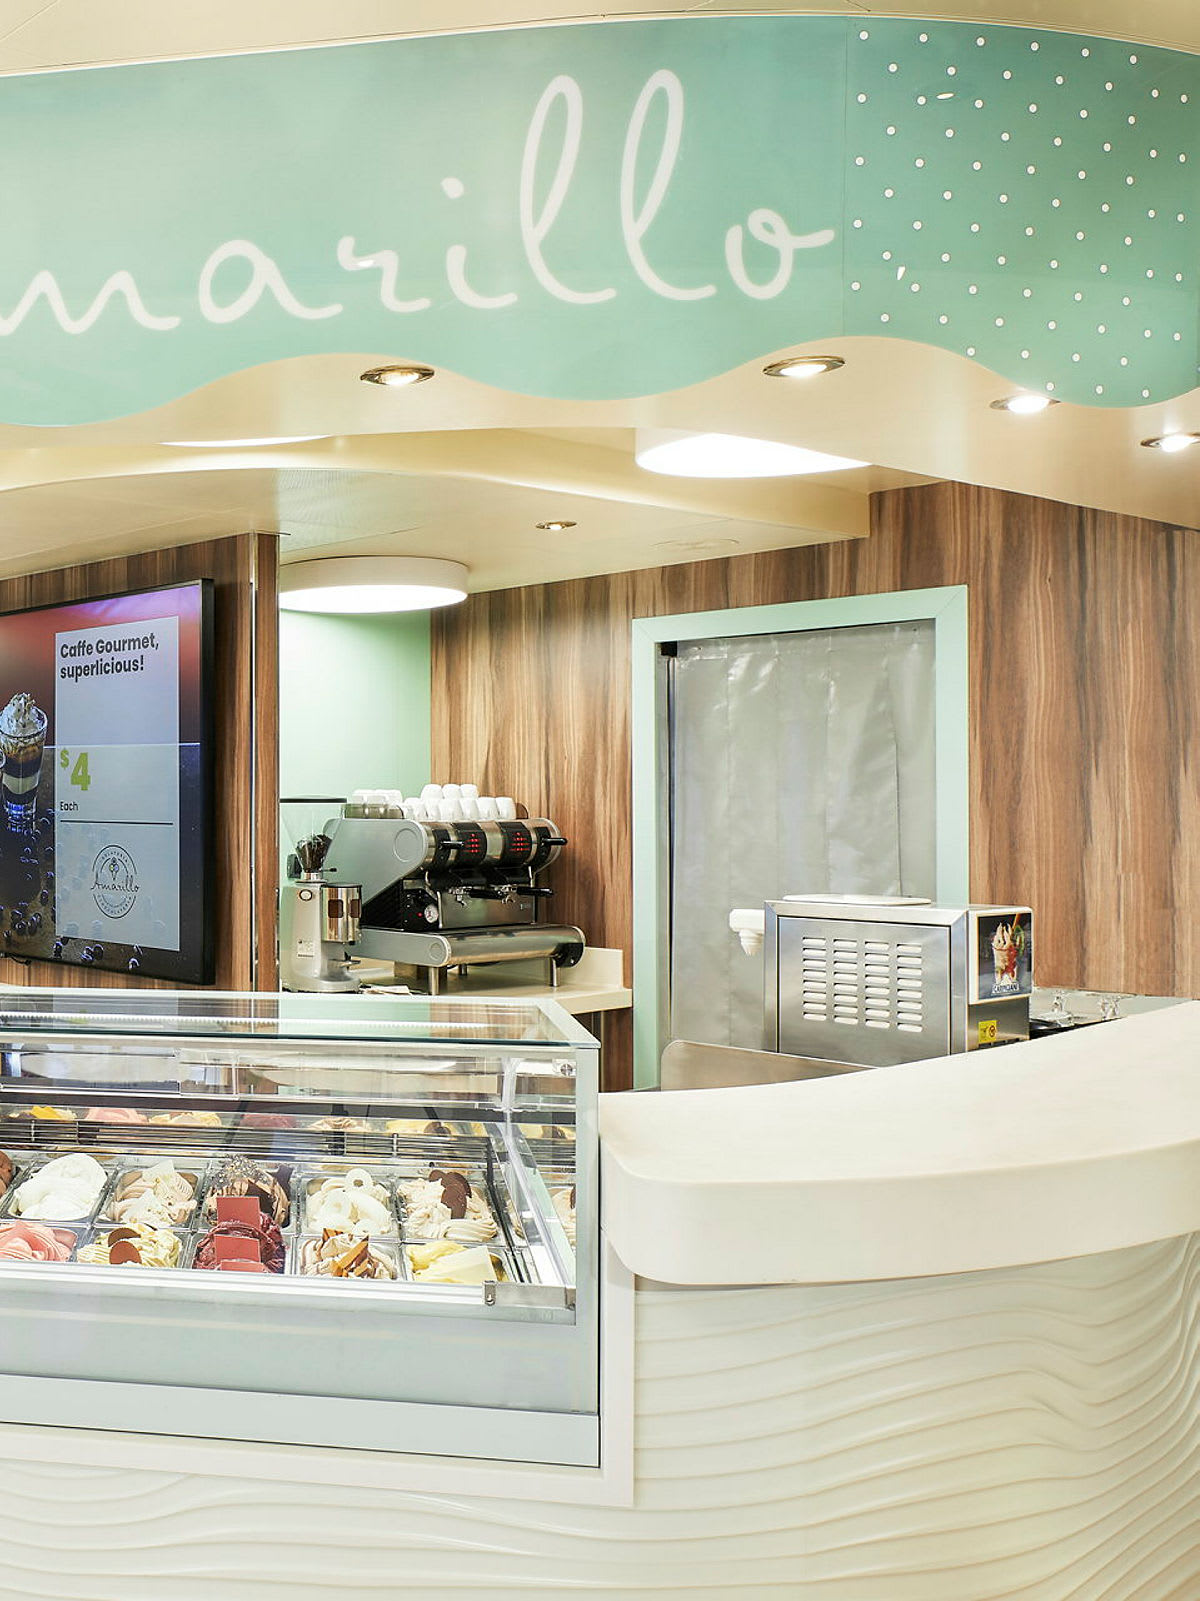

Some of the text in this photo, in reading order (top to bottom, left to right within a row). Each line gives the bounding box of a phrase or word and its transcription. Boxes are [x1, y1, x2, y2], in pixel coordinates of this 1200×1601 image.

[60, 632, 159, 659] Caffe Gourmet,
[60, 655, 144, 683] superlicious!
[60, 801, 79, 811] Each
[90, 871, 140, 893] Amarillo
